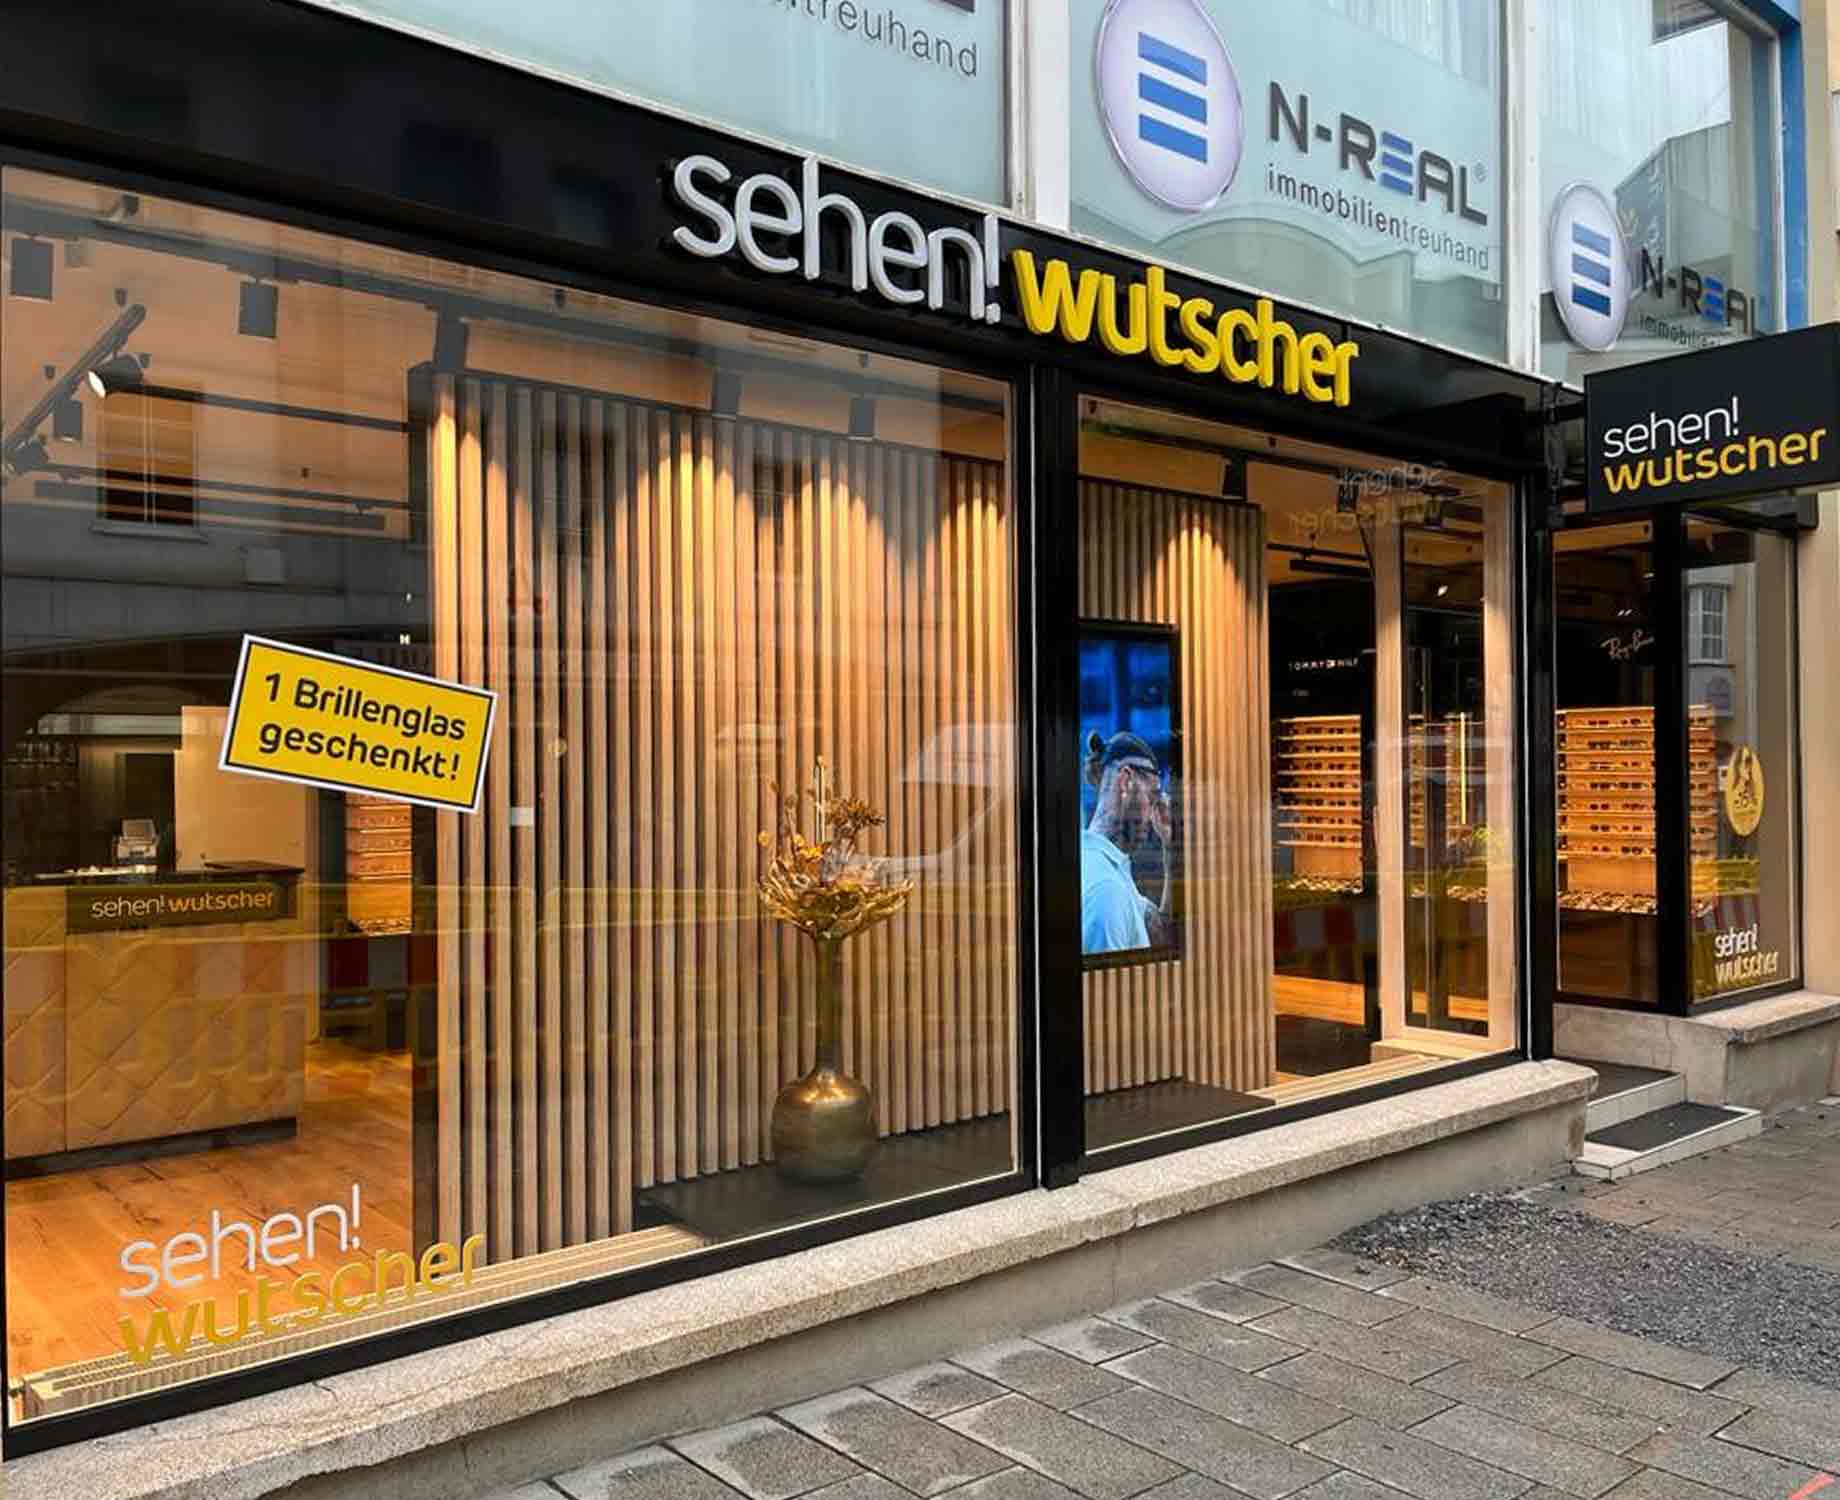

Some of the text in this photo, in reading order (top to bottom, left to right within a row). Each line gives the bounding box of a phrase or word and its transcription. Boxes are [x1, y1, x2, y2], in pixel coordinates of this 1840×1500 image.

[1268, 163, 1489, 270] immobilientreuhand
[673, 154, 1359, 406] sehen! wutscher
[1604, 396, 1739, 458] sehen!
[1604, 429, 1826, 493] wutscher
[265, 673, 465, 740] 1 Brillenglas
[258, 722, 460, 780] geschenkt!
[119, 1183, 361, 1298] sehen!
[118, 1232, 486, 1367] wutscher
